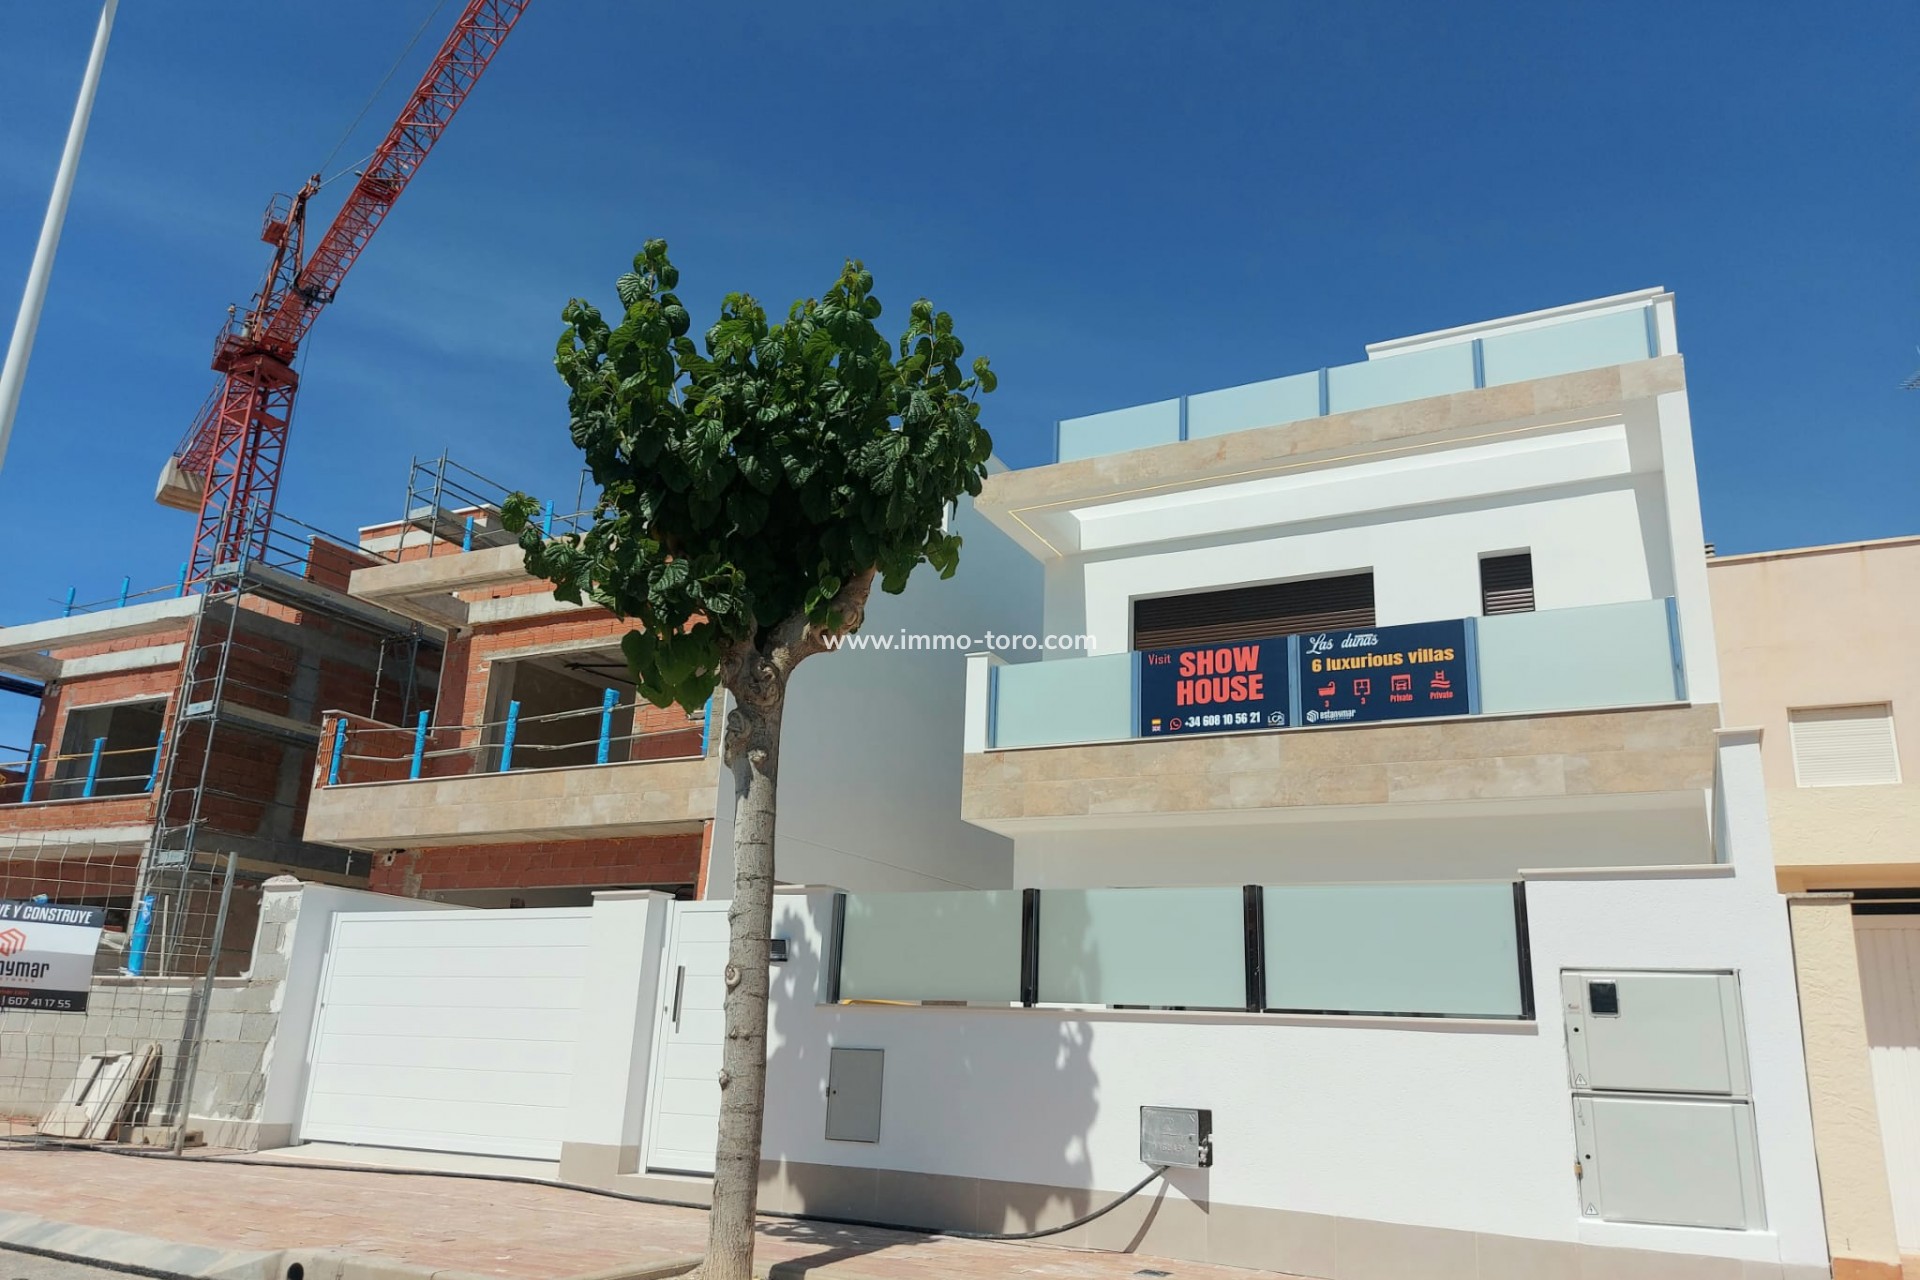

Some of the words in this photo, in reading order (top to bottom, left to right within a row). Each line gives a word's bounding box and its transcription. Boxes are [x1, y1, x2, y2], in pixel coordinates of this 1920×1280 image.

[1306, 633, 1333, 654] Las
[1341, 633, 1378, 648] dunas
[1148, 653, 1171, 665] Visit
[1179, 645, 1260, 677] SHOW
[1312, 658, 1322, 672] 6
[1326, 653, 1403, 671] luxurious
[1408, 647, 1454, 664] villas
[1177, 674, 1263, 706] HOUSE
[1184, 716, 1201, 728] +34
[1223, 713, 1233, 725] 10
[1235, 712, 1248, 724] 56
[1250, 711, 1261, 723] 21
[13, 904, 23, 918] Y
[23, 906, 93, 924] CONSTRUYE
[8, 997, 29, 1005] 607
[31, 999, 42, 1007] 41
[45, 999, 55, 1007] 17
[57, 1000, 71, 1008] 55
